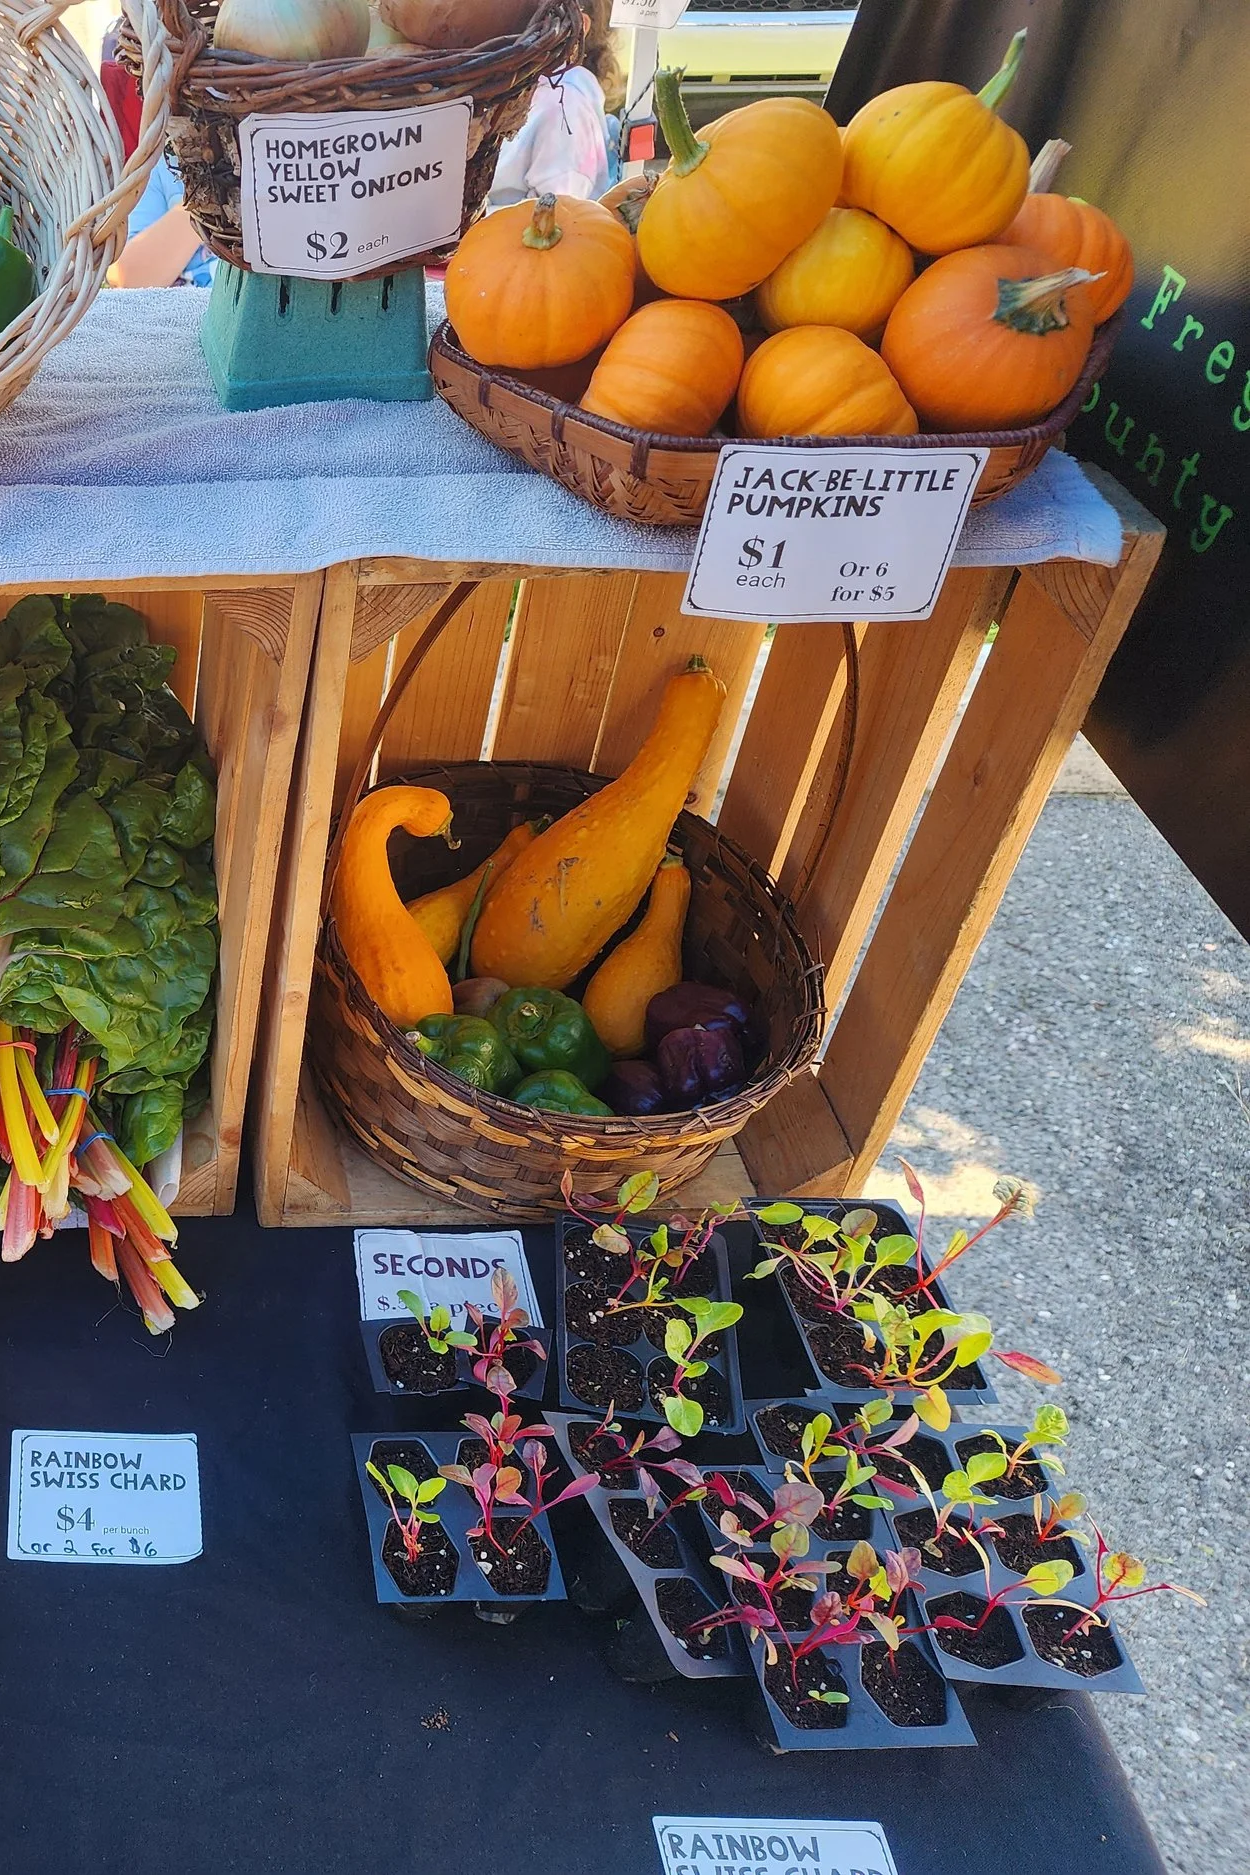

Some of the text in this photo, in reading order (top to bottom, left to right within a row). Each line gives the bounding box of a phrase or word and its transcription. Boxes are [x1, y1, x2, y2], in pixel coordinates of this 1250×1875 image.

[266, 125, 422, 159] HOMEGROWN
[268, 158, 360, 182] YELLOW
[268, 161, 442, 204] SWEET ONIONS
[306, 230, 389, 262] $2 each
[734, 466, 960, 492] JACK-BE-LITTLE
[727, 493, 884, 518] PUMPKINS
[738, 535, 788, 570] $1
[736, 573, 786, 588] each
[839, 561, 888, 578] Or 6
[830, 585, 897, 602] for $5
[377, 1295, 407, 1312] $.5
[450, 1302, 499, 1318] pec
[30, 1450, 142, 1470] RAINBOW
[30, 1471, 186, 1491] SWISS CHARD
[56, 1504, 150, 1536] $4 per bunch
[31, 1542, 52, 1554] or
[64, 1540, 78, 1555] 2
[667, 1832, 820, 1862] RAINBOW
